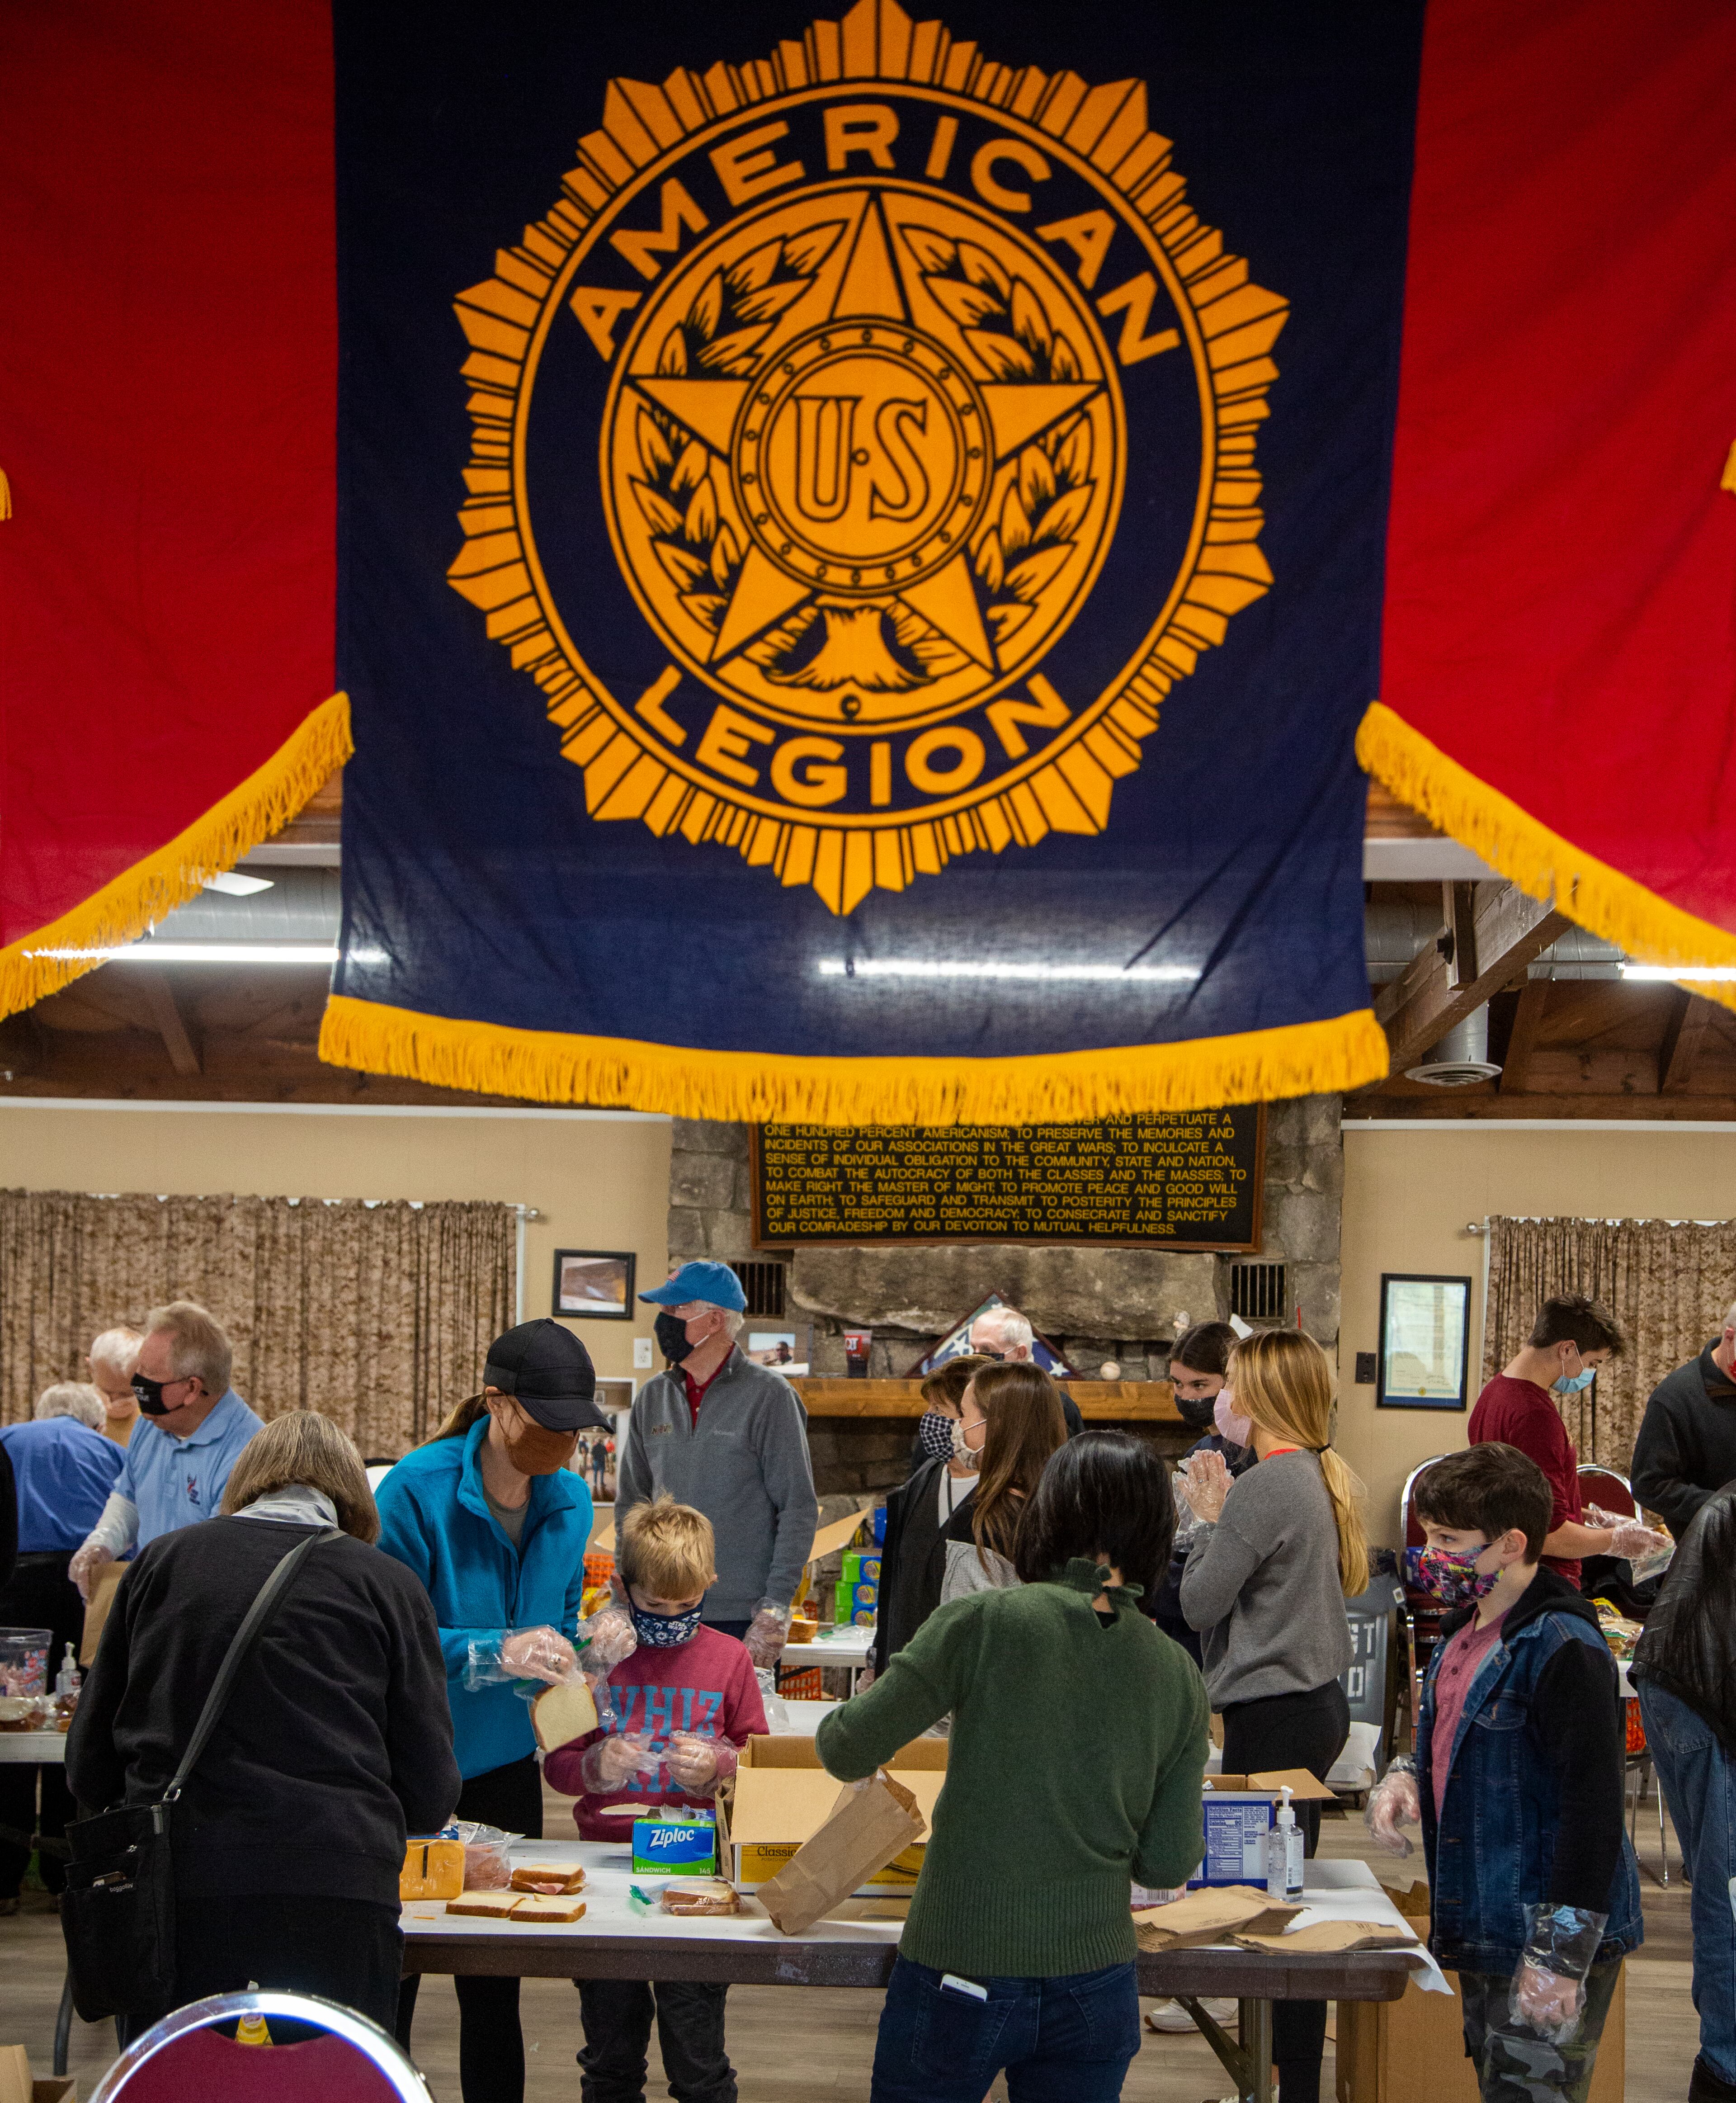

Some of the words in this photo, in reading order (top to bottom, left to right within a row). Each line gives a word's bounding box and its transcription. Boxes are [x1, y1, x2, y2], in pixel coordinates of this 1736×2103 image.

[569, 104, 1181, 367] AMERICAN
[634, 664, 1073, 807] LEGION
[1107, 1114, 1132, 1125] AND
[1137, 1114, 1217, 1125] PERPETUATE
[1222, 1114, 1231, 1125] A
[764, 1125, 791, 1136] ONE
[796, 1126, 854, 1137] HUNDRED
[860, 1127, 916, 1138] PERCENT
[923, 1128, 1010, 1139] AMERICANISM;
[1017, 1128, 1033, 1139] TO
[1038, 1128, 1102, 1139] PRESERVE
[1109, 1129, 1132, 1139] THE
[1137, 1128, 1202, 1139] MEMORIES
[1208, 1128, 1235, 1139] AND
[765, 1139, 828, 1151] INCIDENTS
[833, 1140, 850, 1151] OF
[856, 1140, 882, 1151] OUR
[888, 1140, 979, 1152] ASSOCIATIONS
[984, 1142, 995, 1152] IN
[1001, 1142, 1025, 1152] THE
[1030, 1142, 1071, 1152] GREAT
[1077, 1142, 1116, 1153] WARS;
[1122, 1142, 1138, 1153] TO
[1144, 1142, 1209, 1153] INCULCATE
[1215, 1142, 1224, 1153] A
[765, 1153, 806, 1164] SENSE
[811, 1154, 828, 1165] OF
[833, 1154, 899, 1166] INDIVIDUAL
[905, 1154, 977, 1166] OBLIGATION
[983, 1156, 1000, 1166] TO
[1005, 1156, 1029, 1166] THE
[1034, 1156, 1110, 1167] COMMUNITY,
[1115, 1157, 1152, 1167] STATE
[1157, 1157, 1184, 1167] AND
[1189, 1156, 1236, 1167] NATION,
[766, 1167, 783, 1178] TO
[788, 1167, 838, 1178] COMBAT
[844, 1168, 868, 1179] THE
[875, 1168, 949, 1179] AUTOCRACY
[956, 1169, 973, 1179] OF
[978, 1169, 1012, 1179] BOTH
[1018, 1169, 1042, 1180] THE
[1047, 1169, 1104, 1180] CLASSES
[1110, 1170, 1136, 1180] AND
[1142, 1170, 1165, 1181] THE
[1170, 1170, 1224, 1181] MASSES;
[1230, 1170, 1246, 1180] TO
[766, 1181, 801, 1191] MAKE
[806, 1181, 843, 1191] RIGHT
[849, 1181, 873, 1192] THE
[878, 1182, 929, 1192] MASTER
[934, 1182, 951, 1193] OF
[956, 1182, 995, 1194] MIGHT;
[1000, 1183, 1017, 1193] TO
[1022, 1183, 1083, 1193] PROMOTE
[1088, 1183, 1128, 1194] PEACE
[1135, 1184, 1160, 1194] AND
[1166, 1184, 1203, 1194] GOOD
[1209, 1184, 1238, 1194] WILL
[767, 1195, 785, 1205] ON
[790, 1195, 834, 1206] EARTH;
[840, 1195, 856, 1205] TO
[861, 1196, 935, 1205] SAFEGUARD
[941, 1195, 967, 1205] AND
[972, 1196, 1035, 1206] TRANSMIT
[1041, 1196, 1057, 1206] TO
[1062, 1196, 1132, 1207] POSTERITY
[1138, 1197, 1162, 1207] THE
[1168, 1197, 1236, 1208] PRINCIPLES
[767, 1208, 785, 1219] OF
[788, 1208, 840, 1219] JUSTICE,
[844, 1208, 904, 1218] FREEDOM
[910, 1208, 935, 1218] AND
[940, 1208, 1019, 1219] DEMOCRACY;
[1026, 1209, 1042, 1219] TO
[1047, 1209, 1130, 1220] CONSECRATE
[1136, 1210, 1162, 1220] AND
[1167, 1210, 1228, 1221] SANCTIFY
[769, 1222, 796, 1233] OUR
[799, 1221, 888, 1233] COMRADESHIP
[892, 1221, 909, 1232] BY
[914, 1222, 940, 1231] OUR
[945, 1221, 1007, 1231] DEVOTION
[1013, 1221, 1029, 1232] TO
[1034, 1221, 1083, 1232] MUTUAL
[1089, 1222, 1176, 1233] HELPFULNESS.
[650, 1828, 695, 1848] Ziploc
